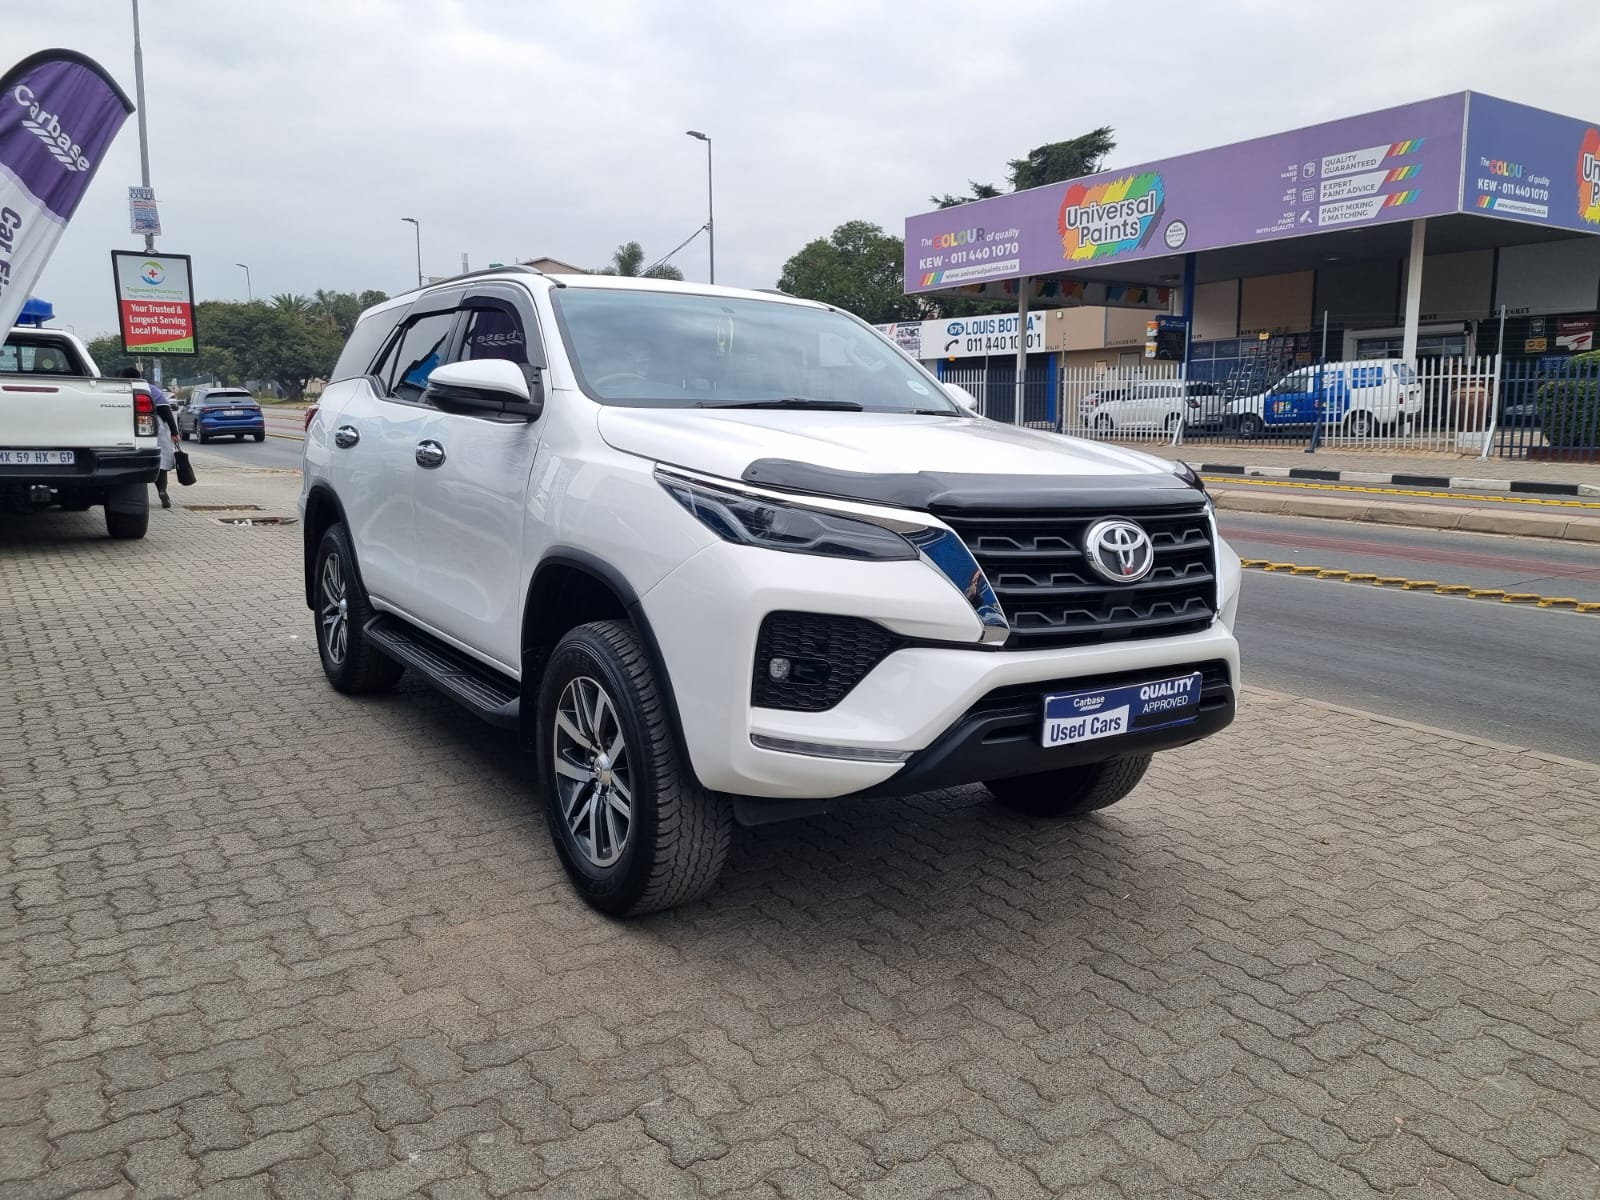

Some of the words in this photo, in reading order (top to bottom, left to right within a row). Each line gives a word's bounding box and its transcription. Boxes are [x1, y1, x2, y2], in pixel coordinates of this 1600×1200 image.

[14, 85, 90, 171] Carbase
[1324, 155, 1357, 167] QUALITY
[1324, 159, 1377, 174] GUARANTEED
[1480, 157, 1490, 168] The
[1323, 180, 1353, 191] EXPERT
[1323, 189, 1345, 199] PAINT
[1346, 184, 1376, 194] ADVICE
[1478, 178, 1498, 192] KEW
[1502, 183, 1514, 195] 011
[1515, 186, 1530, 198] 440
[1531, 189, 1549, 201] 1070
[1067, 192, 1155, 228] Universal
[1321, 206, 1344, 215] PAINT
[1345, 201, 1374, 211] MIXING
[1327, 210, 1369, 222] MATCHING
[1080, 218, 1139, 246] Paints
[1271, 223, 1295, 232] QUALITY
[921, 238, 933, 247] The
[933, 227, 985, 249] COLOUR
[986, 231, 995, 241] of
[995, 228, 1020, 241] quality
[920, 255, 944, 270] KEW
[951, 251, 967, 264] 011
[969, 247, 990, 261] 440
[991, 242, 1019, 257] 1070
[131, 304, 147, 313] Your
[148, 304, 176, 314] Trusted
[176, 306, 183, 314] &
[129, 315, 158, 325] Longest
[159, 316, 187, 327] Serving
[965, 320, 995, 335] LOUIS
[998, 316, 1034, 333] BOTA
[130, 325, 151, 335] Local
[151, 326, 187, 337] Pharmacy
[967, 338, 982, 352] 011
[985, 336, 1006, 350] 440
[16, 452, 30, 463] 59
[35, 452, 49, 463] HX
[60, 452, 73, 463] GP
[1140, 677, 1194, 700] QUALITY
[1073, 696, 1105, 707] Carbase
[1142, 695, 1189, 714] APPROVED
[1050, 716, 1086, 742] Used
[1090, 716, 1122, 735] Cars
